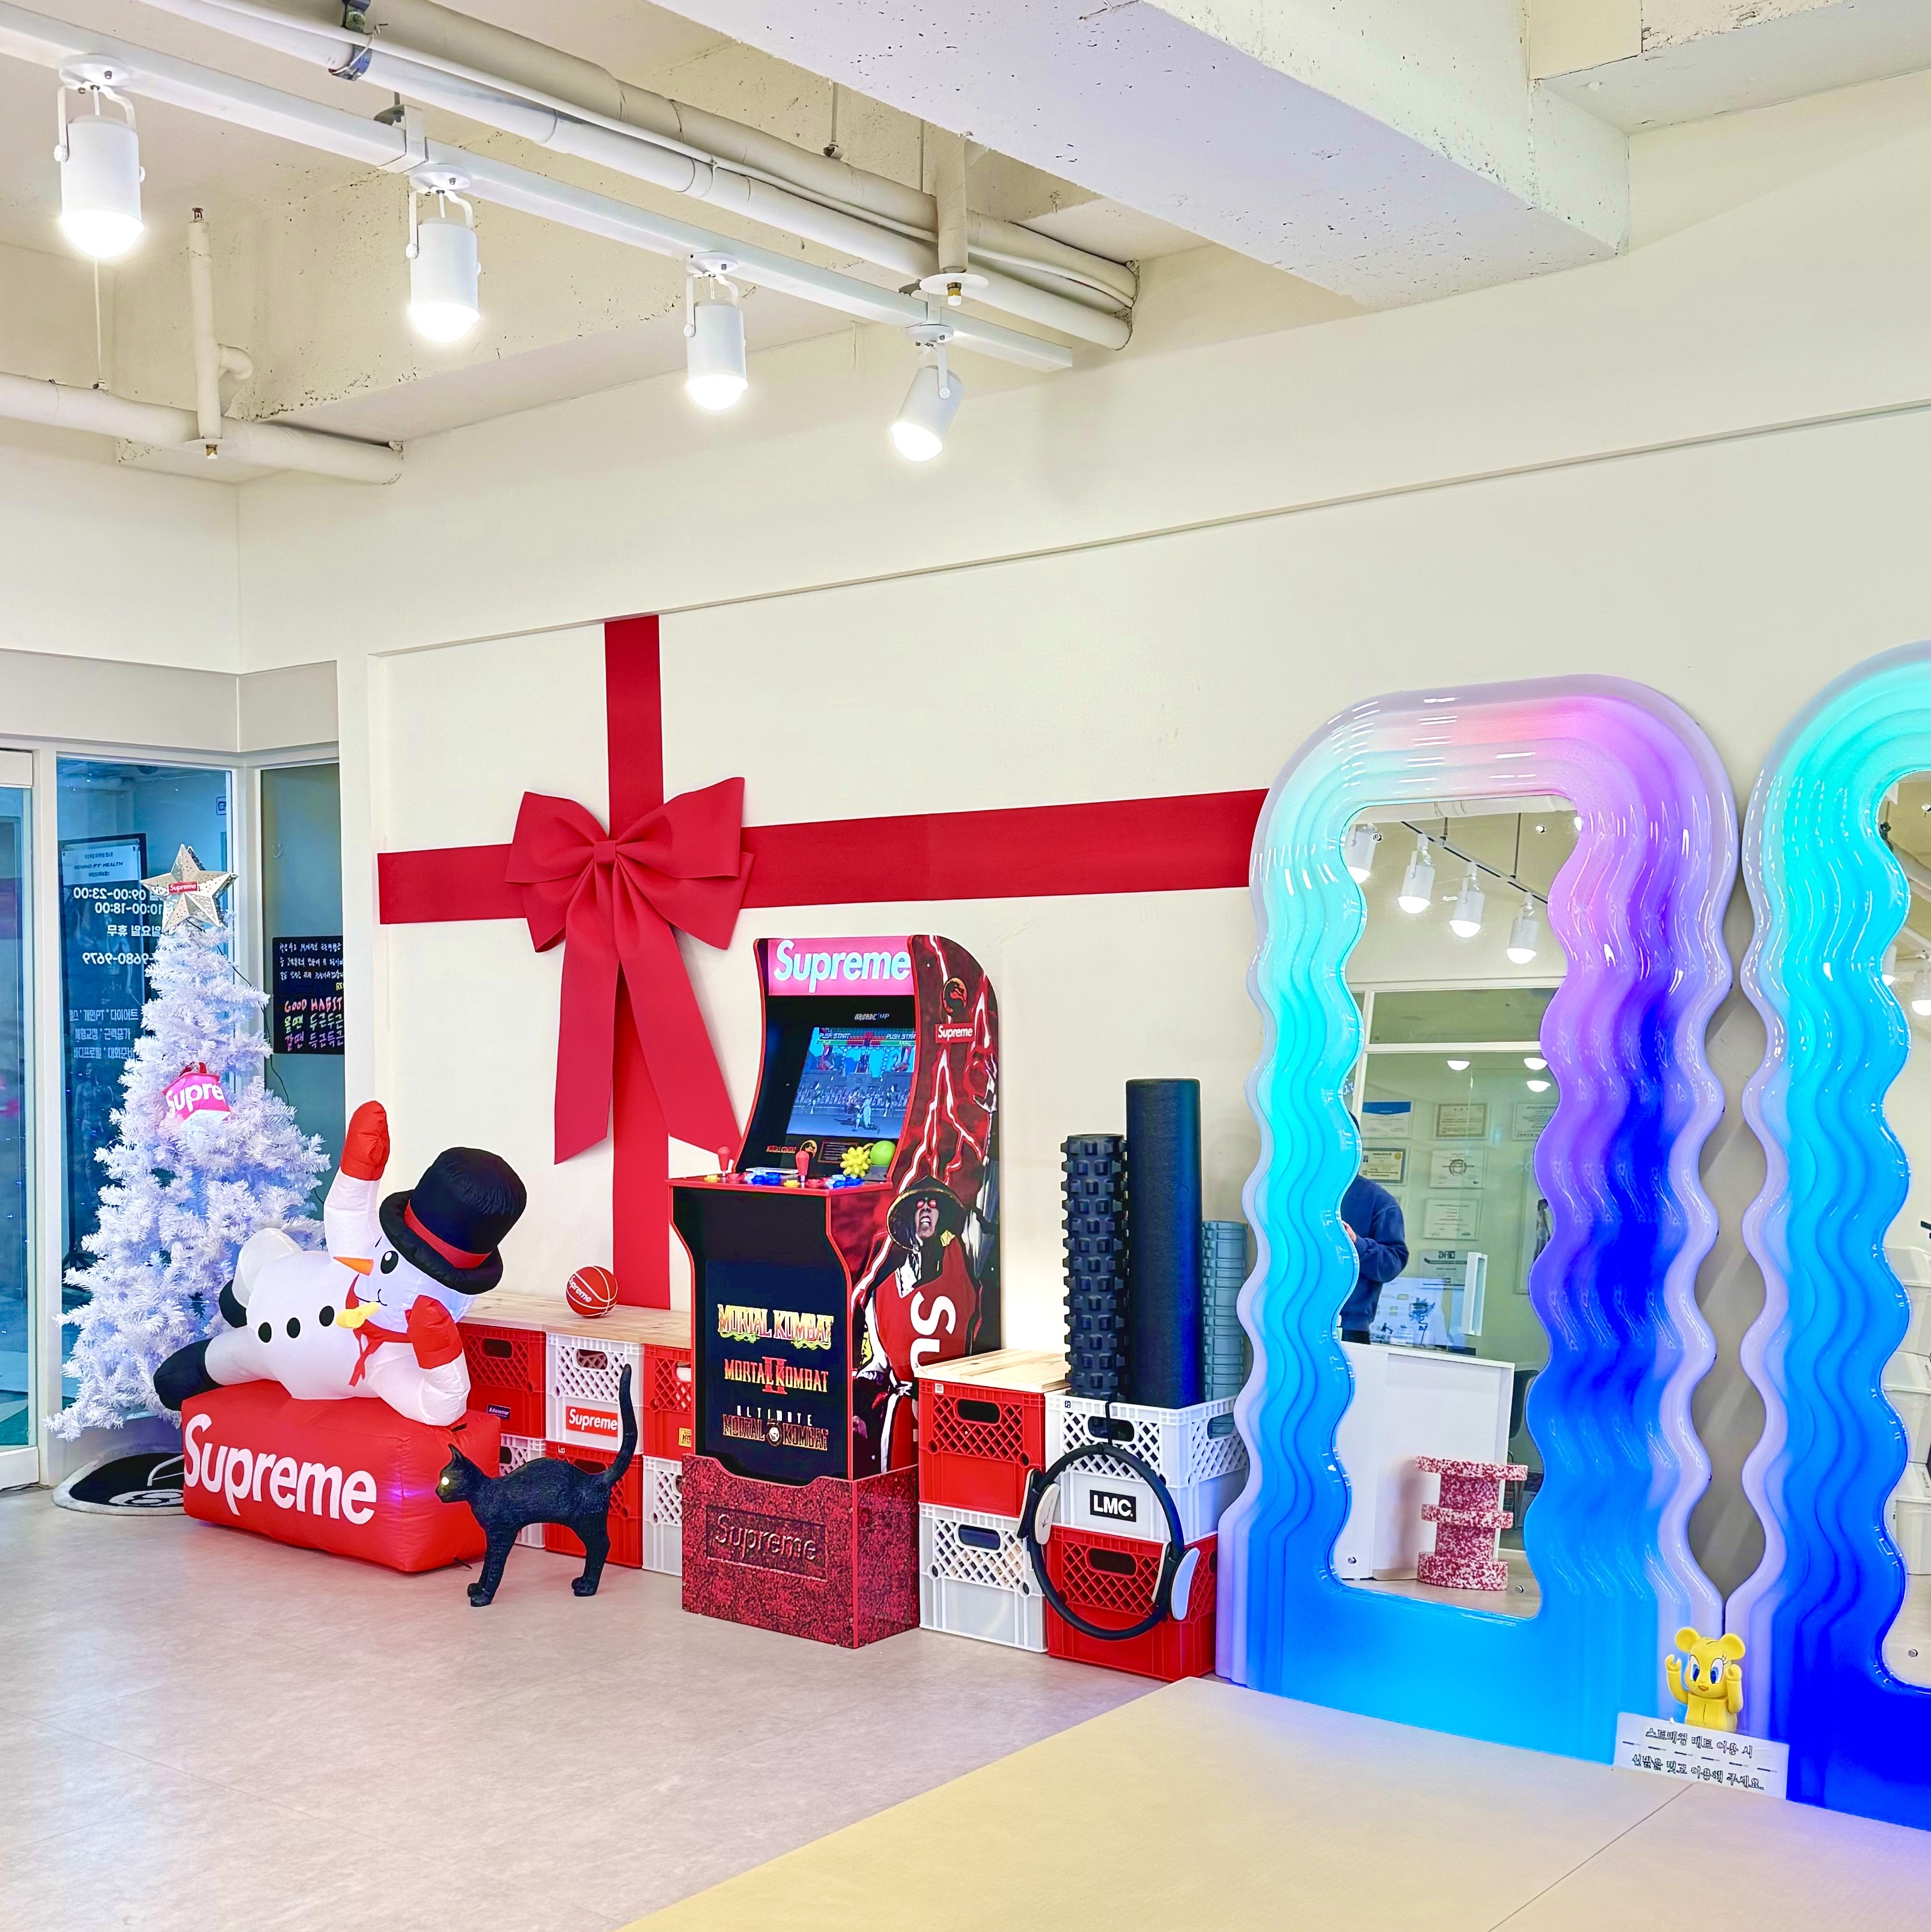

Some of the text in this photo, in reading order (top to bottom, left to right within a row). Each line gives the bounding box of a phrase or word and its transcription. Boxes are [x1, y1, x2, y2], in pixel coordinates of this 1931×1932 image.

[773, 940, 911, 992] Supreme
[111, 1009, 139, 1021] 다이어트
[284, 996, 343, 1013] GOOD HABIT
[310, 1012, 343, 1031] 두근두근
[938, 1025, 973, 1042] Supreme
[718, 1304, 834, 1345] MORTAL KOMBAT
[724, 1359, 774, 1385] MORTAL
[775, 1364, 828, 1392] KOMBAT
[569, 1408, 618, 1431] Supreme
[184, 1413, 377, 1524] Supreme
[715, 1513, 817, 1561] Supreme
[1691, 1735, 1713, 1749] 매트
[1716, 1740, 1739, 1755] 이용
[1742, 1745, 1753, 1759] 시
[1632, 1753, 1663, 1771] 신발을
[1667, 1760, 1687, 1775] 벗고
[1691, 1765, 1724, 1783] 이용해
